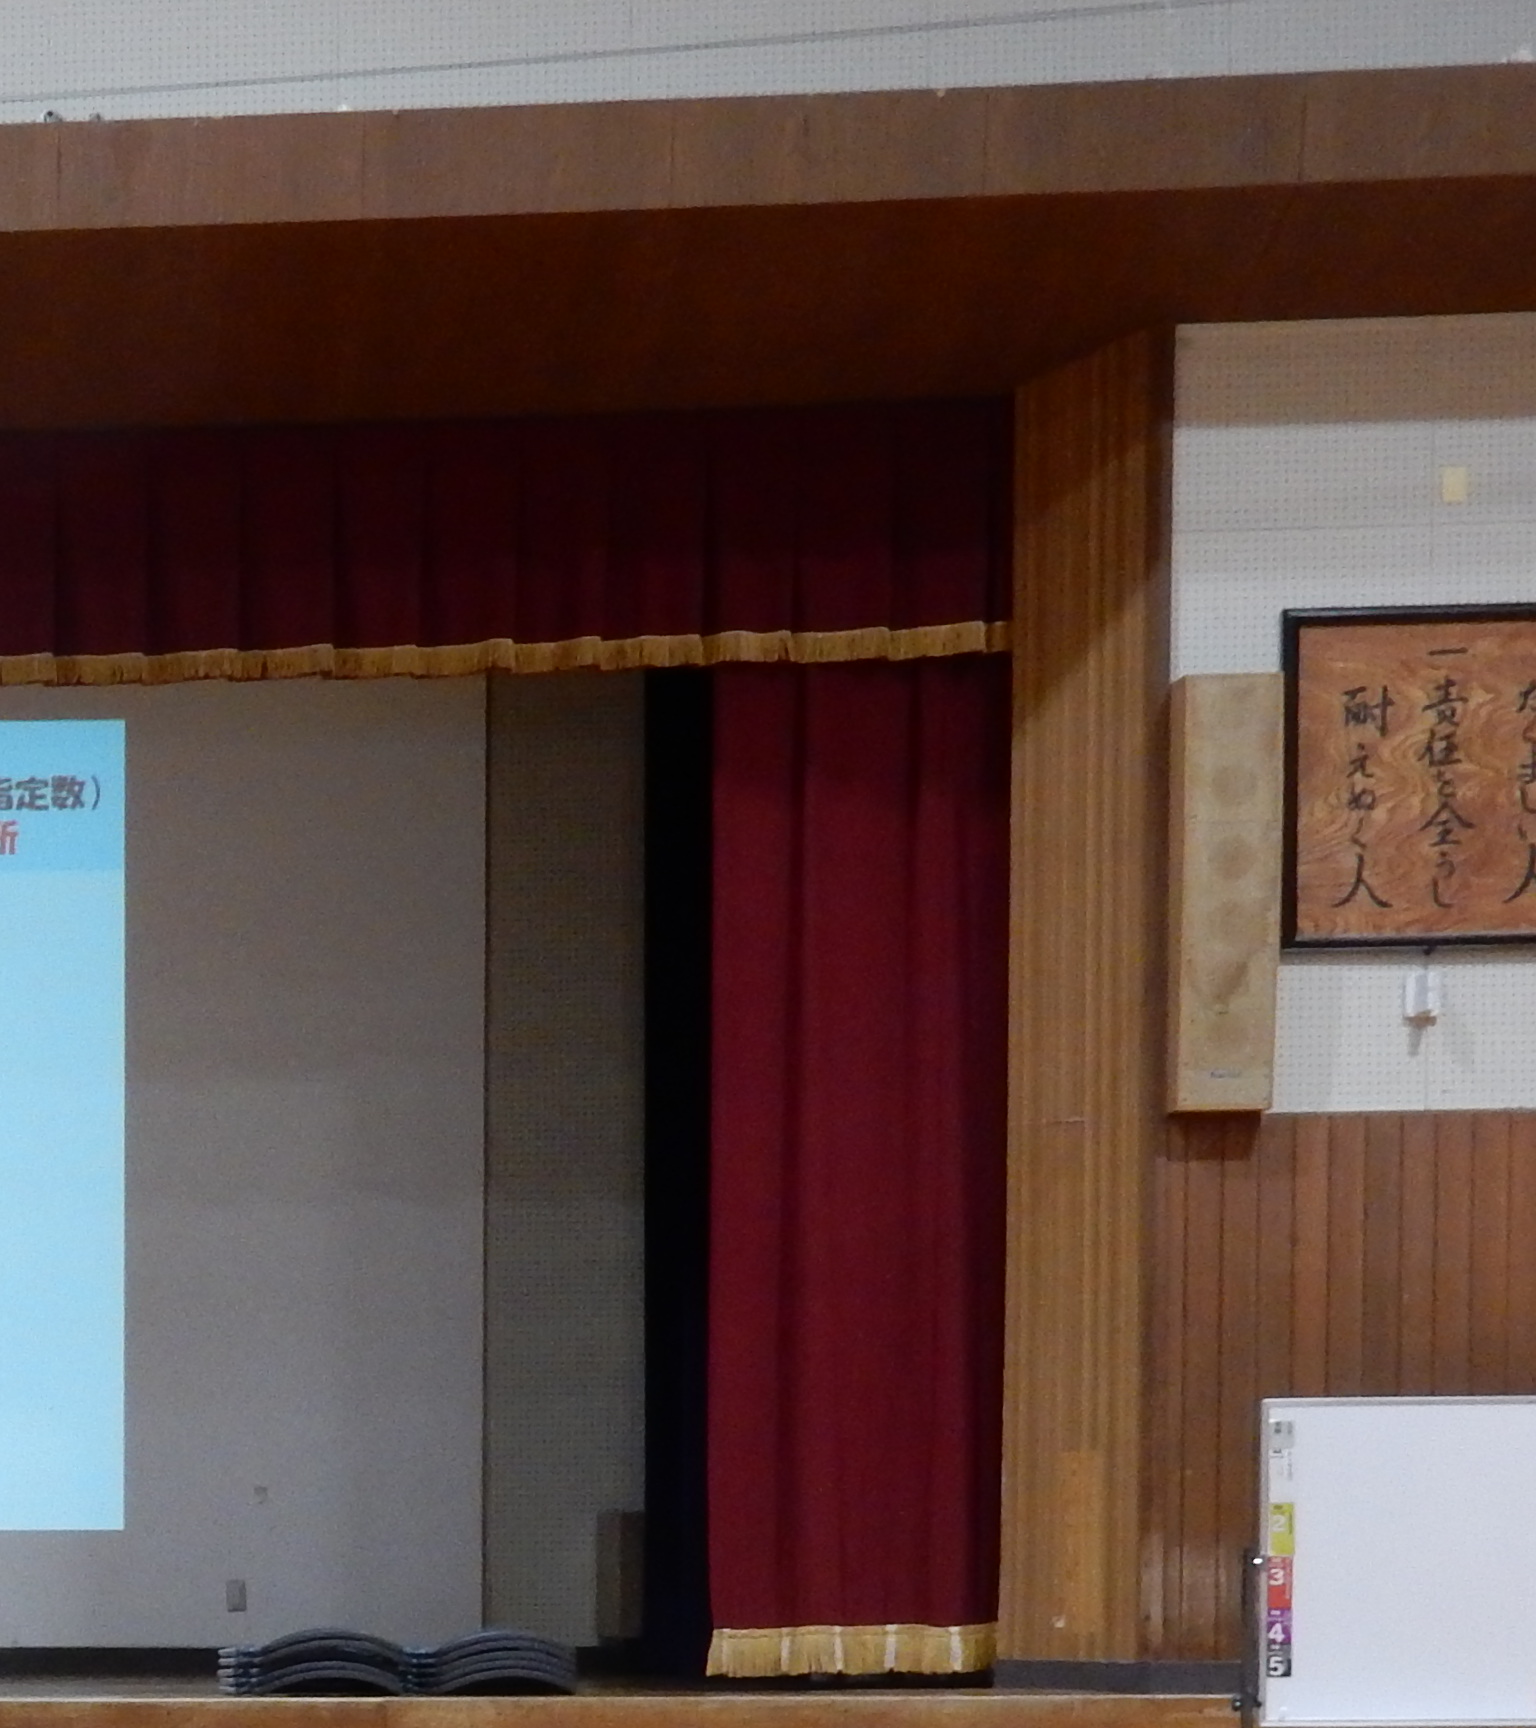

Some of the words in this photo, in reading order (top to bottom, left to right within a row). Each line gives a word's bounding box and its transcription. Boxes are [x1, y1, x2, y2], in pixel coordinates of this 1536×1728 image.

[1270, 1568, 1285, 1586] 3
[1268, 1622, 1285, 1643] 4
[1268, 1657, 1285, 1677] 5
